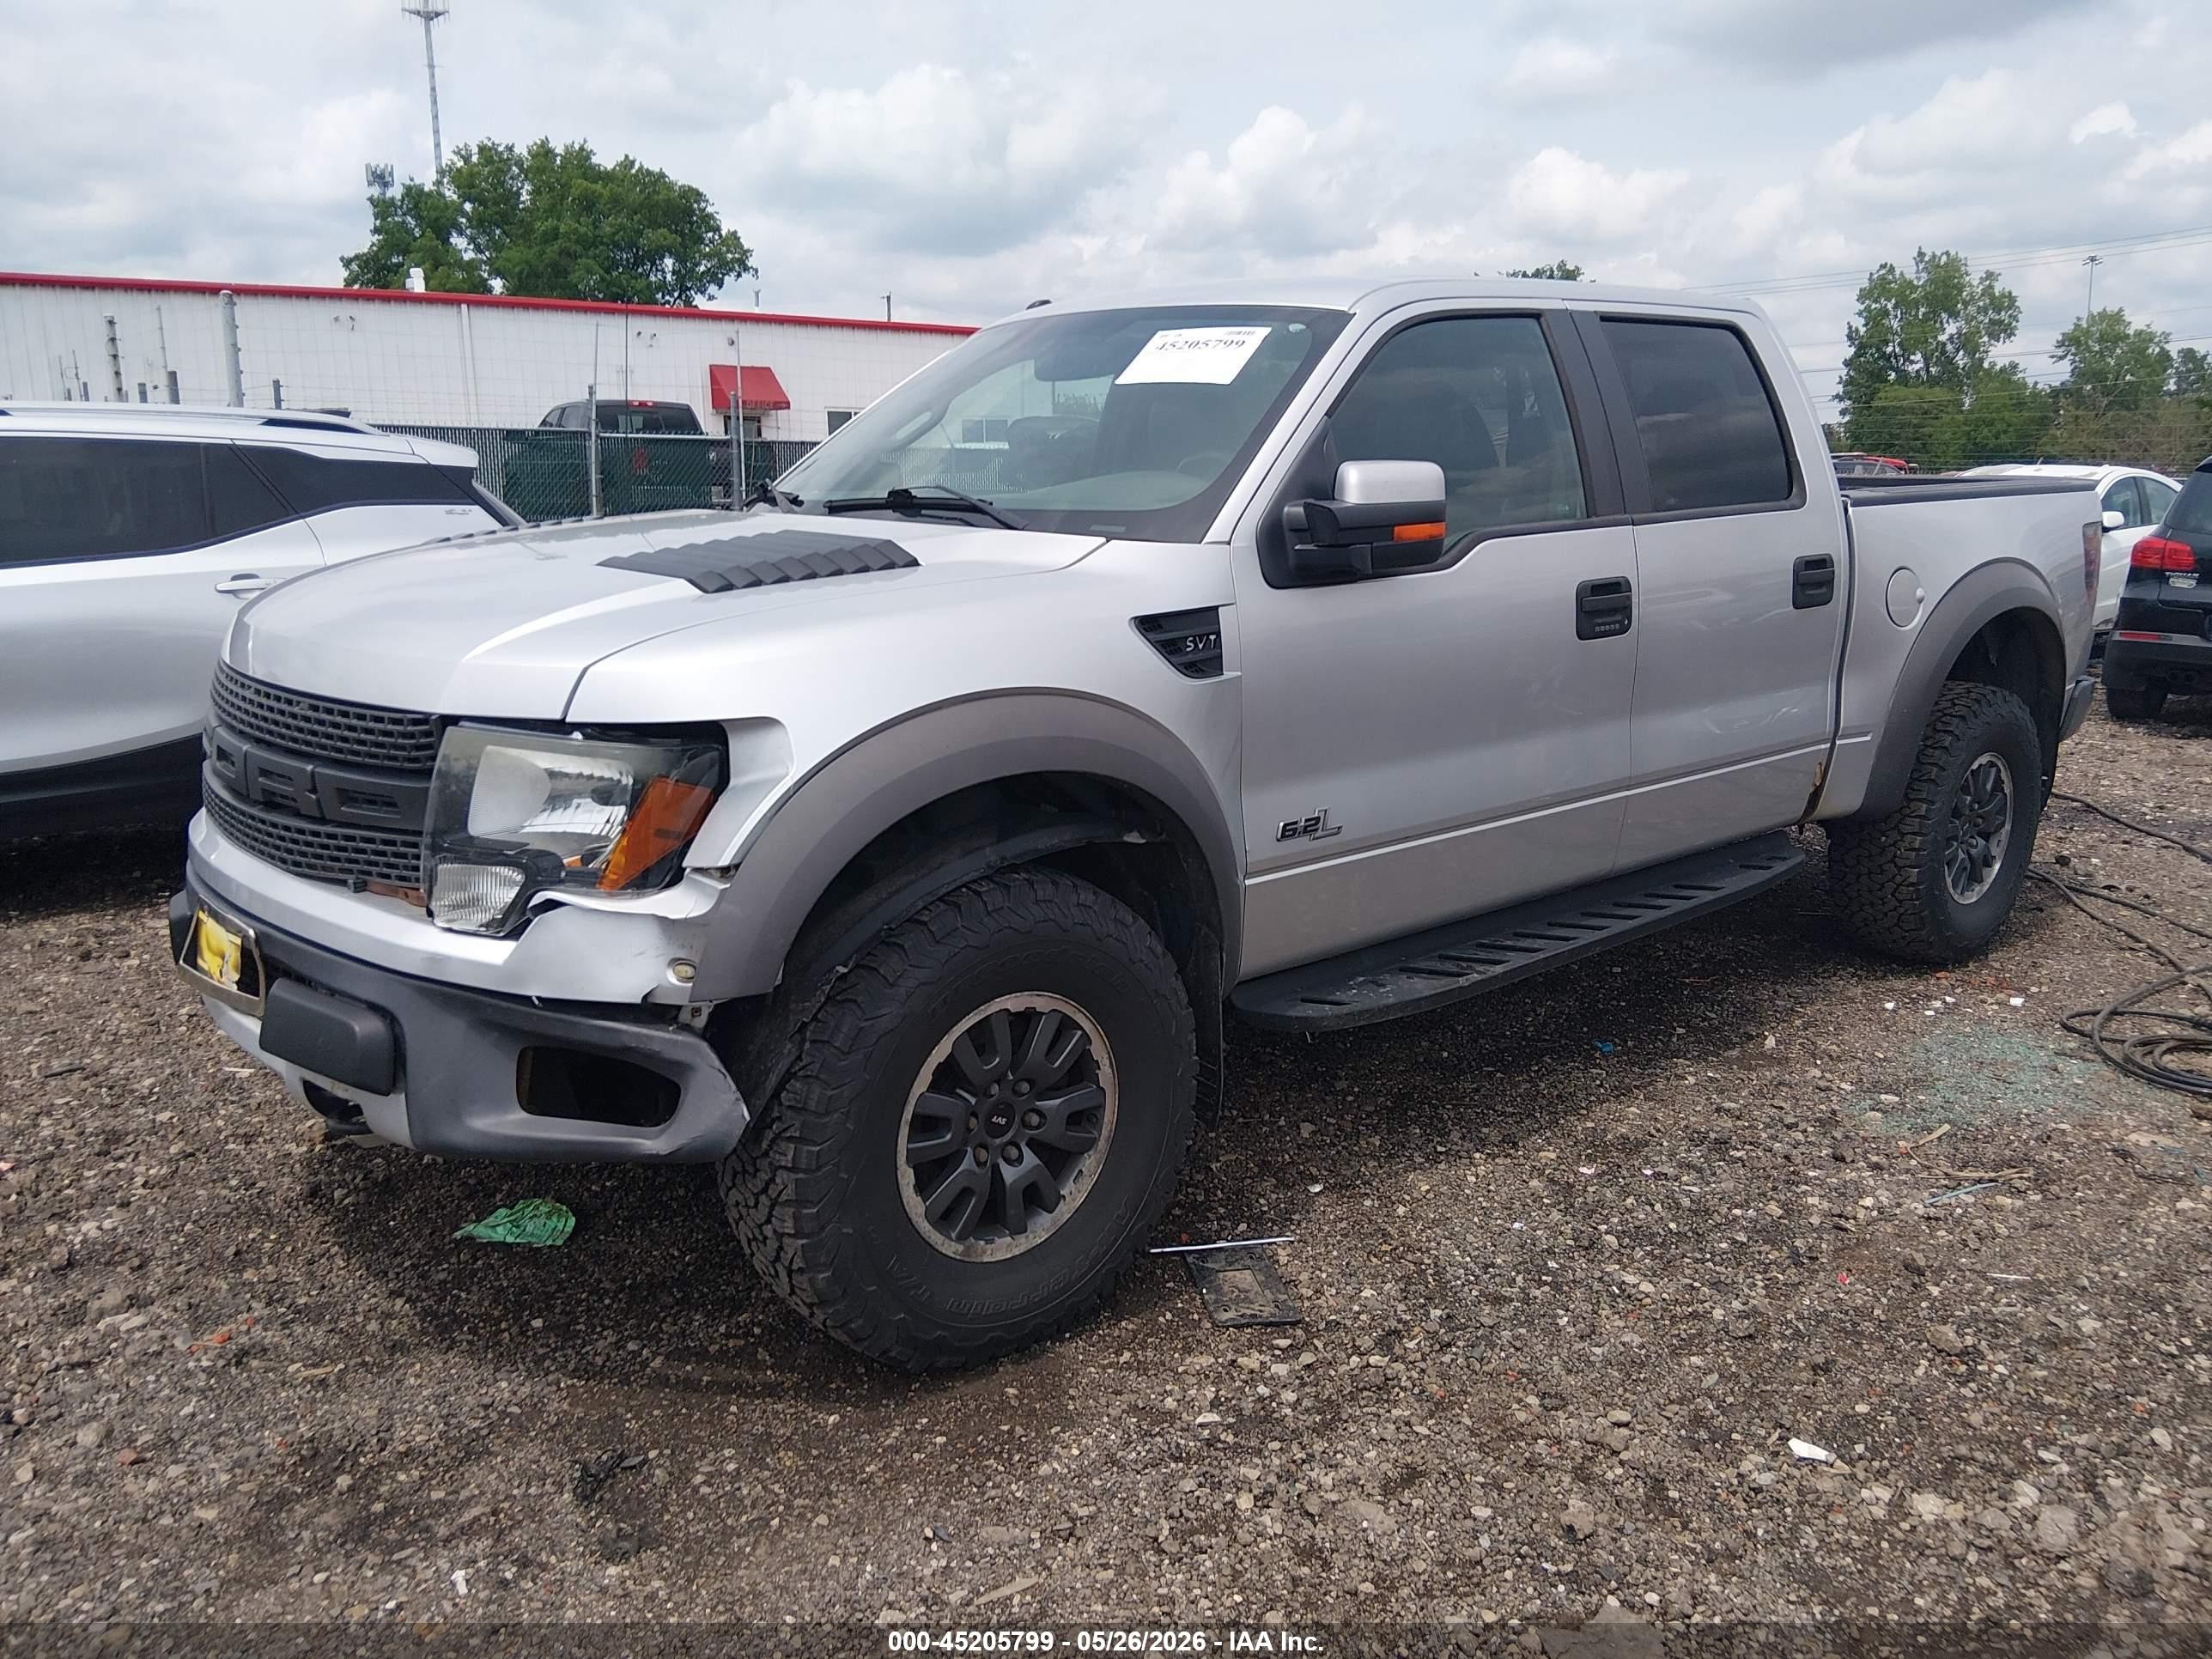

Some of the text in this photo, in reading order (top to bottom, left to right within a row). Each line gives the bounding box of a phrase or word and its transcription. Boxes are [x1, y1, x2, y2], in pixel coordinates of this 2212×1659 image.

[1156, 339, 1246, 350] 45205799
[1185, 635, 1218, 652] SVT
[1276, 807, 1342, 842] 6.2L
[991, 1115, 1007, 1125] SVT
